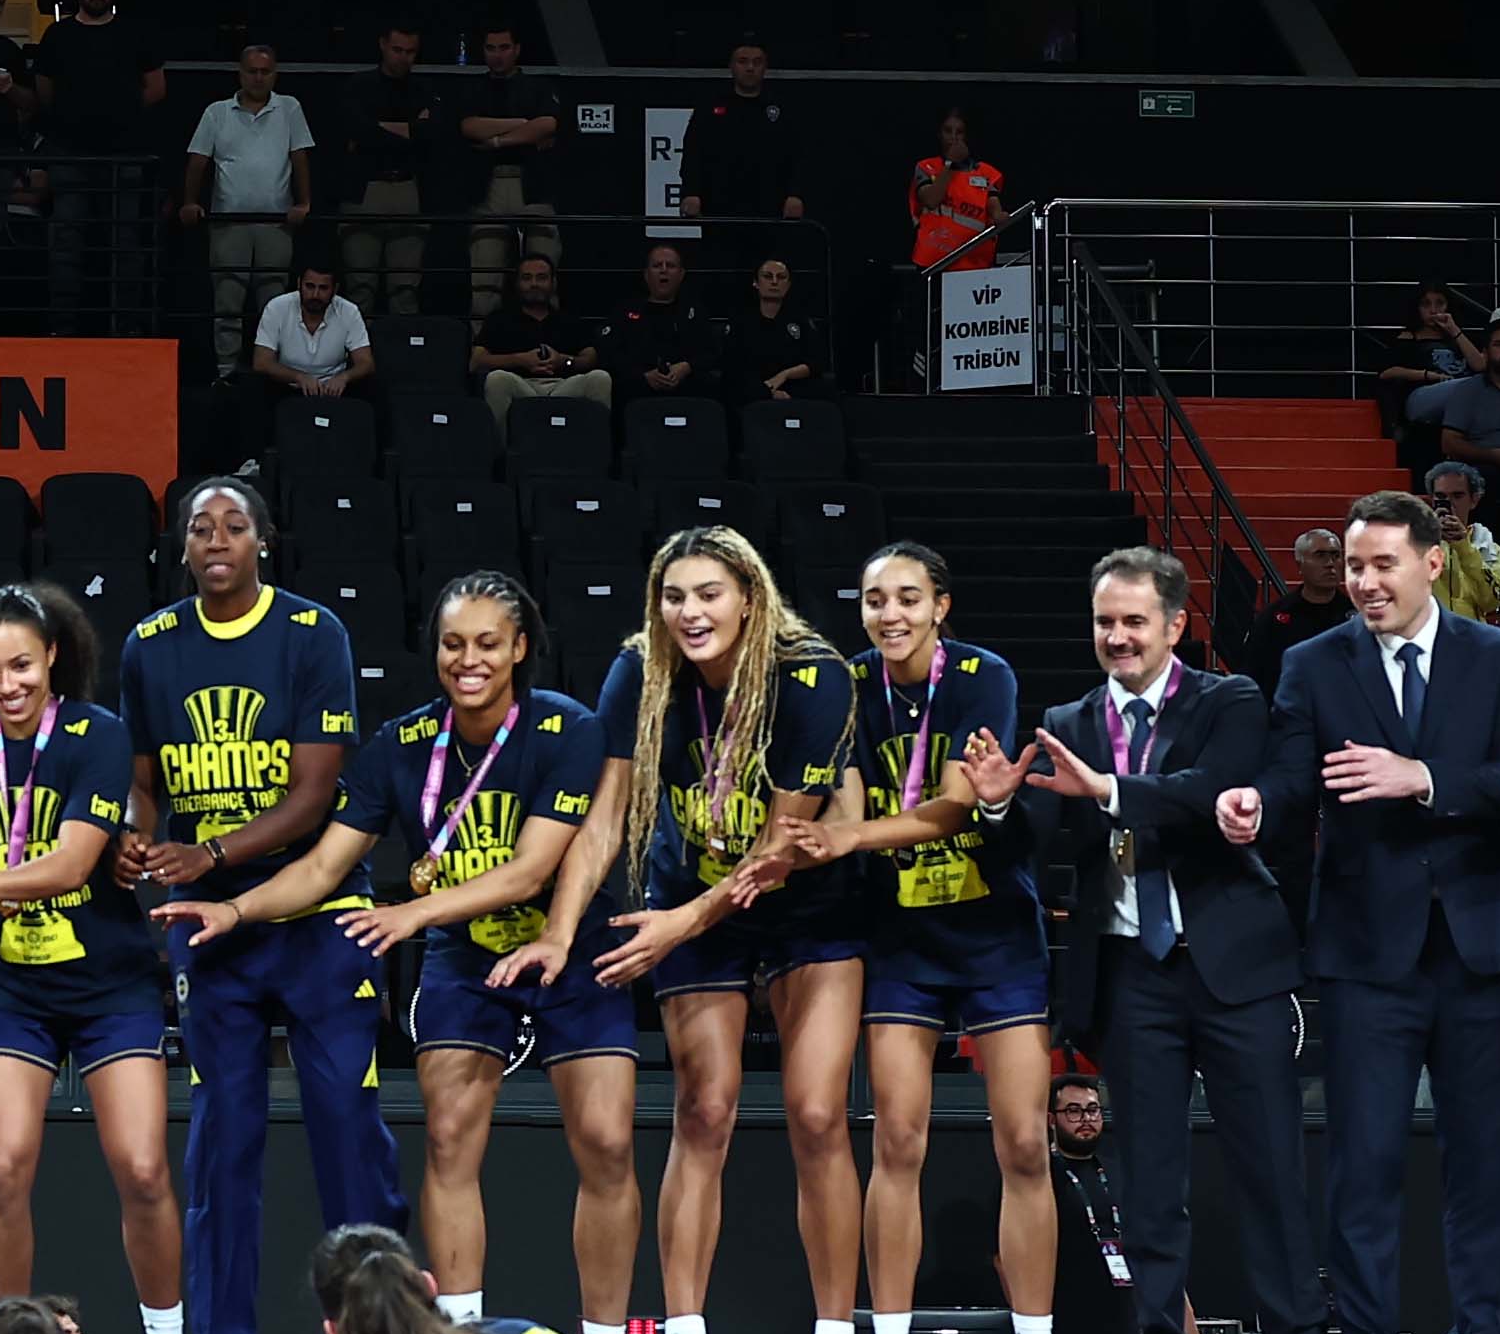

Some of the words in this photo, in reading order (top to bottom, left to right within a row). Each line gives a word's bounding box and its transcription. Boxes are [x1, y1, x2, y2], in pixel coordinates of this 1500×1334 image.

[581, 108, 611, 121] R-1
[972, 284, 1002, 306] VİP
[945, 315, 1030, 340] KOMBİNE
[953, 347, 1020, 371] TRİBÜN
[135, 611, 179, 641] tarfin
[397, 715, 440, 745] tarfin
[159, 739, 292, 794] CHAMPS
